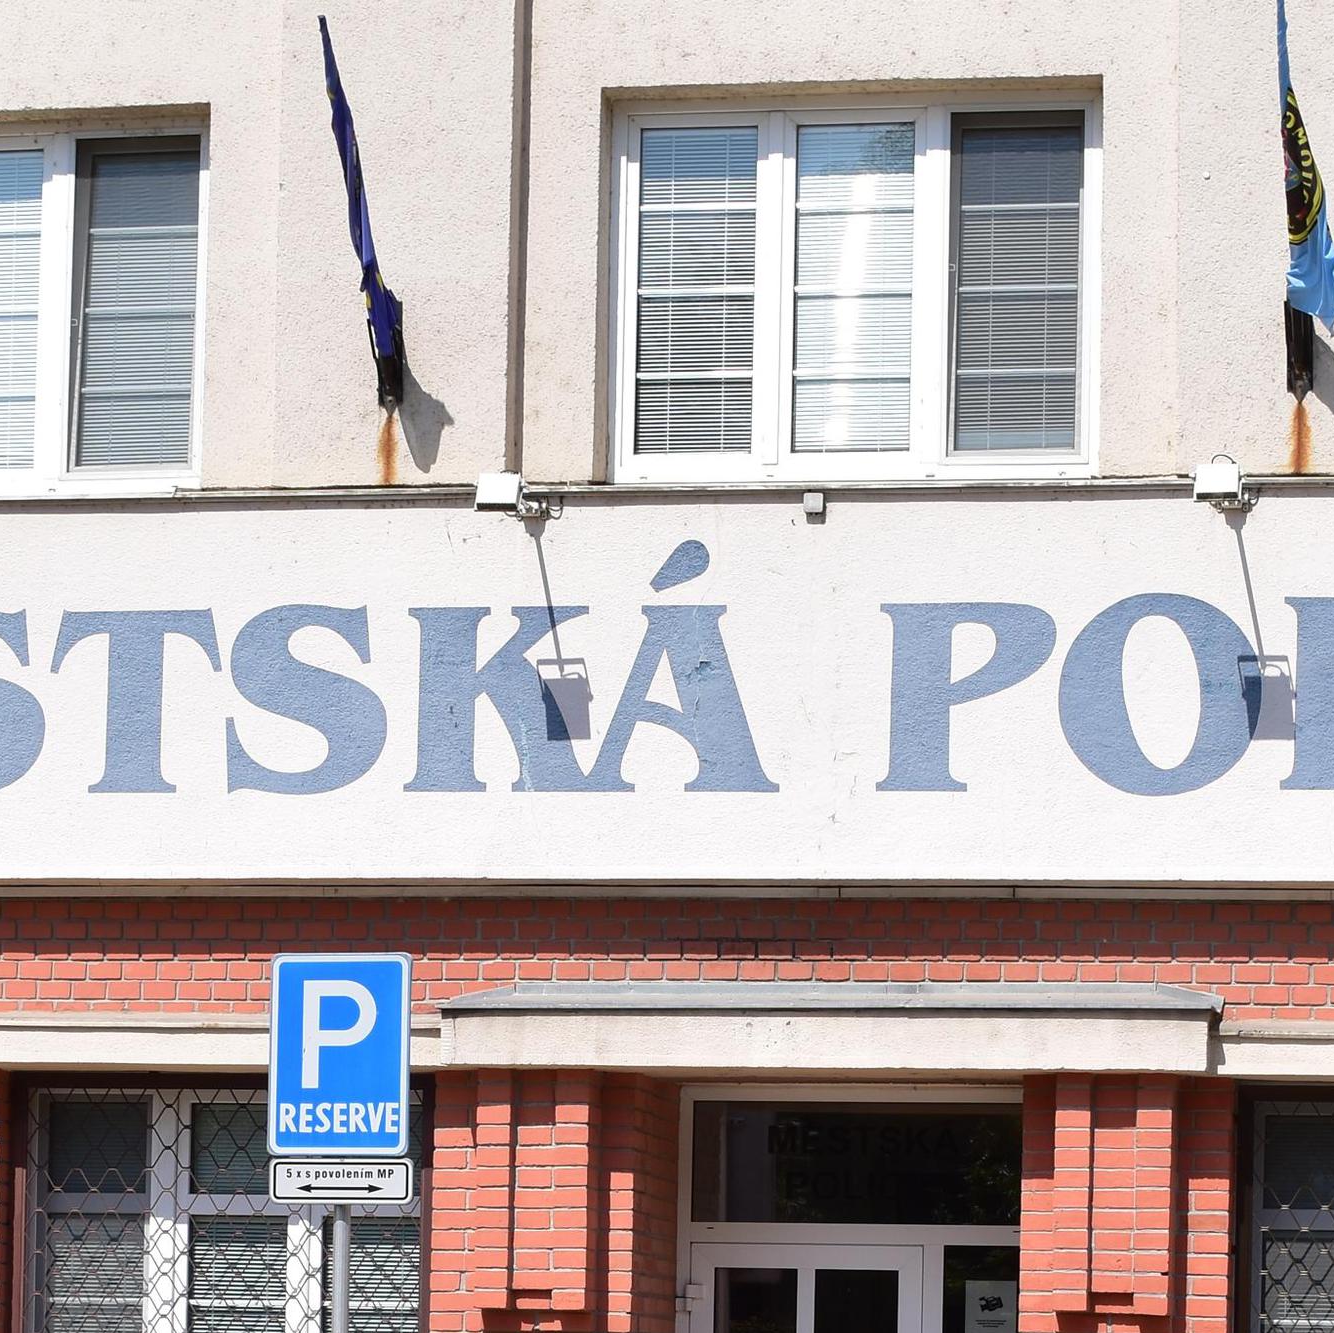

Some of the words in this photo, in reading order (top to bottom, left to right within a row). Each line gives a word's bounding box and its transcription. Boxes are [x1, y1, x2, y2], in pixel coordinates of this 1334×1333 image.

[301, 980, 377, 1089] P
[279, 1102, 399, 1133] RESERVE
[286, 1168, 292, 1179] 5
[296, 1170, 302, 1178] x
[305, 1170, 311, 1178] s
[314, 1168, 374, 1180] povolením
[377, 1169, 395, 1179] MP
